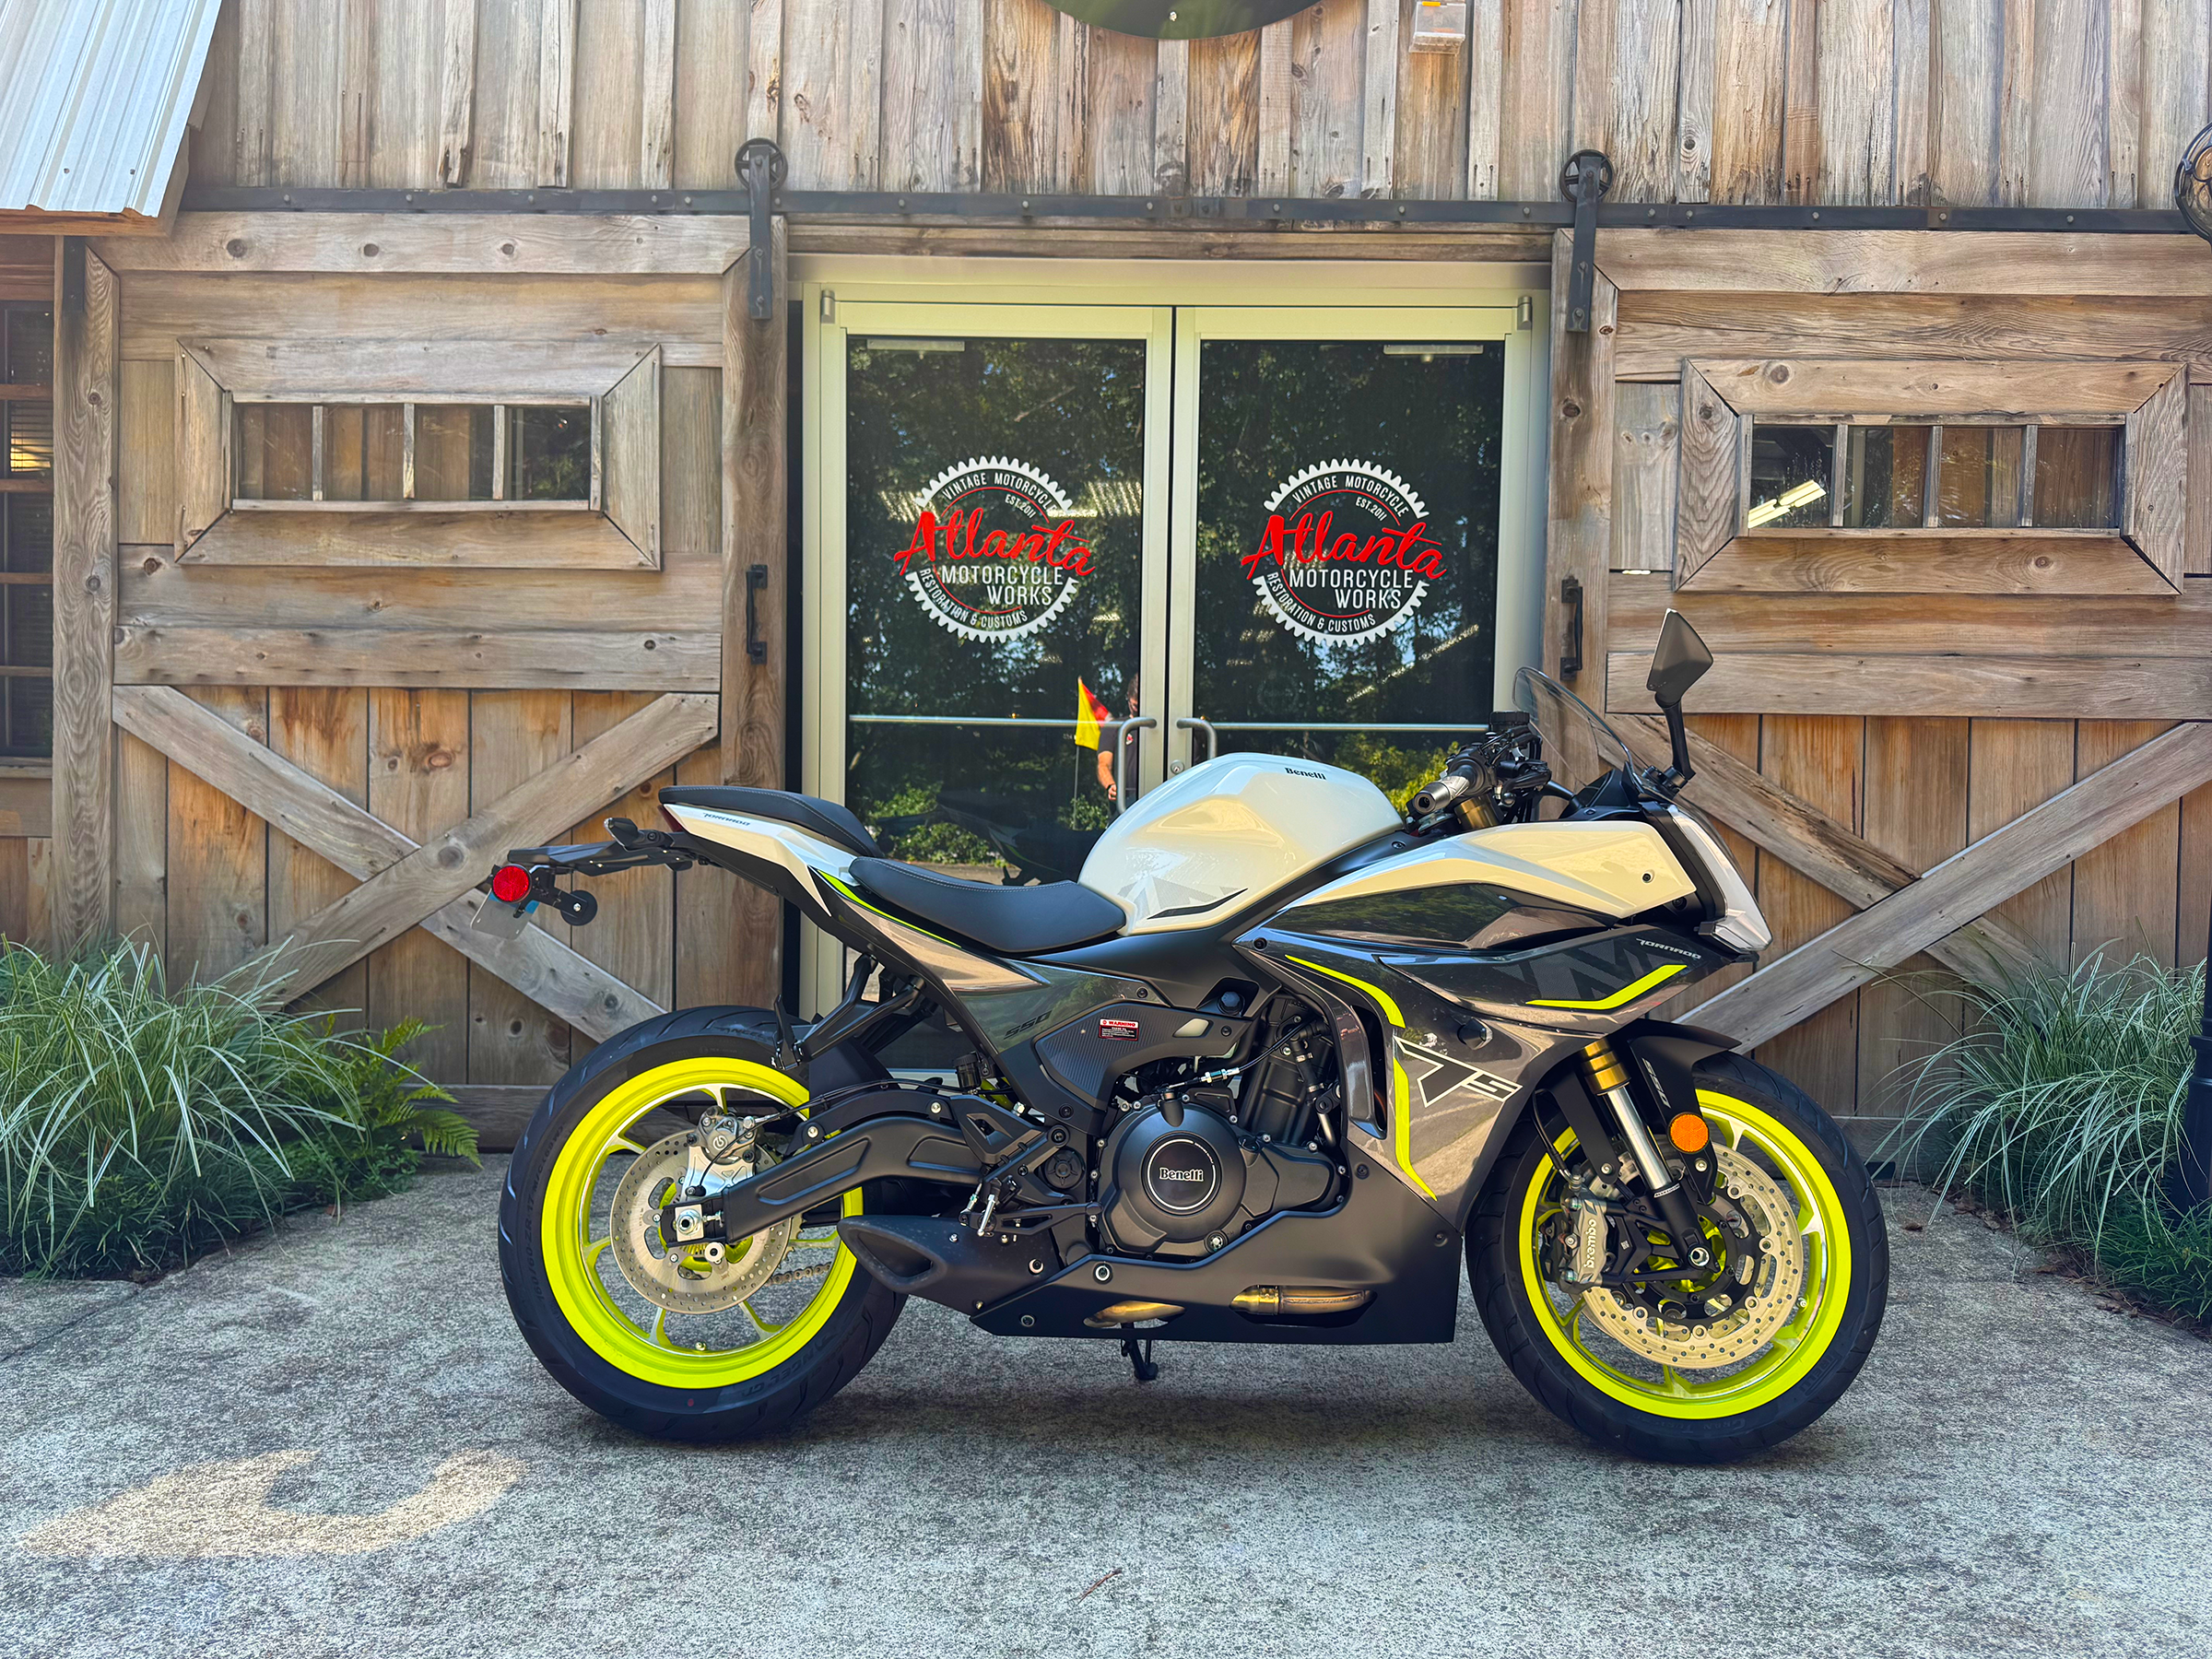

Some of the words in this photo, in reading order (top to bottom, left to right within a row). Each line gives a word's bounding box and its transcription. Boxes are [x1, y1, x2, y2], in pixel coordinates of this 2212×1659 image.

[942, 472, 987, 501] VINTAGE
[994, 472, 1059, 512] MOTORCYCLE
[1292, 475, 1338, 504] VINTAGE
[1345, 475, 1409, 518] MOTORCYCLE
[893, 507, 1097, 577] Atlanta
[1241, 510, 1448, 581] Atlanta
[941, 565, 1064, 585] MOTORCYCLE
[1288, 569, 1414, 589] MOTORCYCLE
[919, 568, 969, 620] RESTORATION
[970, 613, 977, 626] &
[981, 610, 1029, 629] CUSTOMS
[986, 585, 1053, 606] WORKS
[1266, 571, 1317, 627] RESTORATION
[1317, 618, 1324, 630] &
[1327, 614, 1376, 633] CUSTOMS
[1335, 589, 1402, 609] WORKS
[1284, 767, 1327, 781] Benelli
[1635, 937, 1702, 960] TORNADO
[1159, 1167, 1205, 1182] Benelli
[1583, 1218, 1597, 1269] brembo
